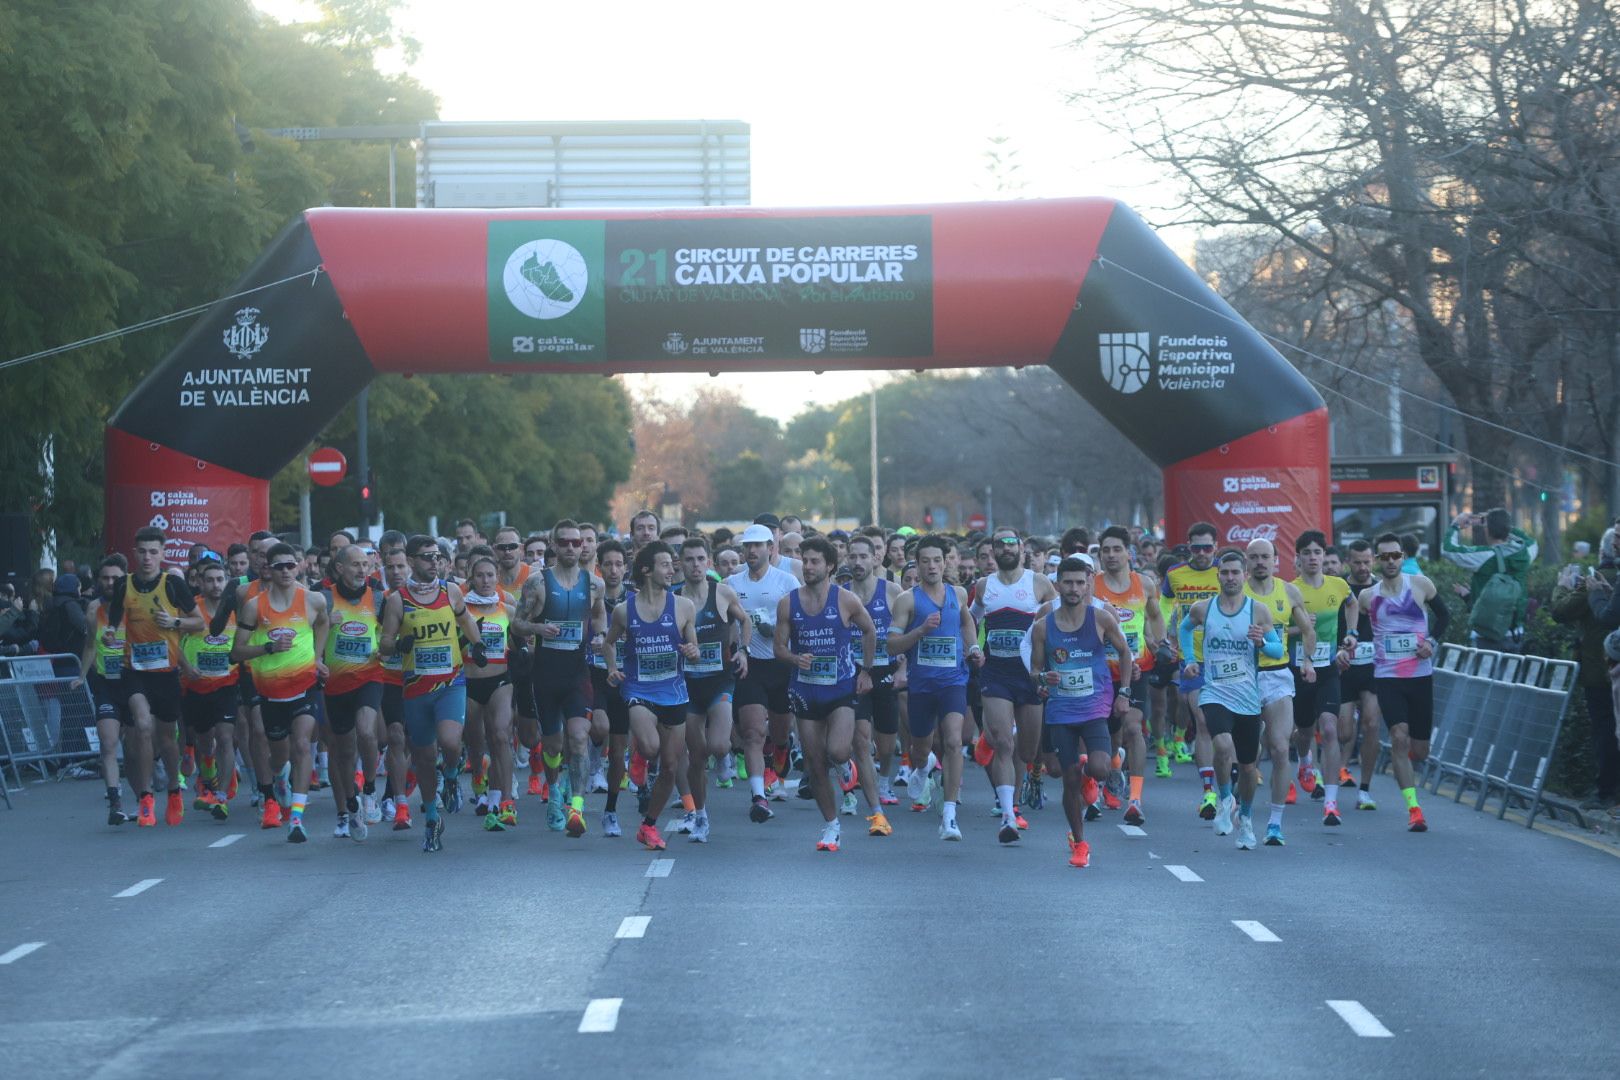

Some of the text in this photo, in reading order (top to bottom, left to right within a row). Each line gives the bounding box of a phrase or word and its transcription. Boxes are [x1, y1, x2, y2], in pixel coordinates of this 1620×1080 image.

[674, 244, 919, 264] CIRCUIT DE CARRERES
[619, 248, 668, 287] 21
[674, 261, 905, 286] CAIXA POPULAR
[678, 287, 698, 302] DE
[537, 336, 575, 344] caixa
[691, 337, 764, 346] AJUNTAMENT
[1158, 333, 1228, 348] Fundació
[691, 345, 707, 354] DE
[1158, 347, 1233, 363] Esportiva
[181, 367, 312, 387] AJUNTAMENT
[1158, 361, 1236, 379] Municipal
[1158, 376, 1226, 391] València
[179, 386, 311, 407] DE VALÈNCIA
[167, 498, 209, 506] popular
[171, 518, 209, 526] TRINIDAD
[412, 621, 451, 641] UPV
[336, 640, 367, 653] 2071
[635, 634, 670, 645] POBLATS
[1397, 638, 1410, 649] 13
[920, 642, 952, 655] 2175
[1222, 662, 1239, 674] 28
[1068, 674, 1085, 686] 34
